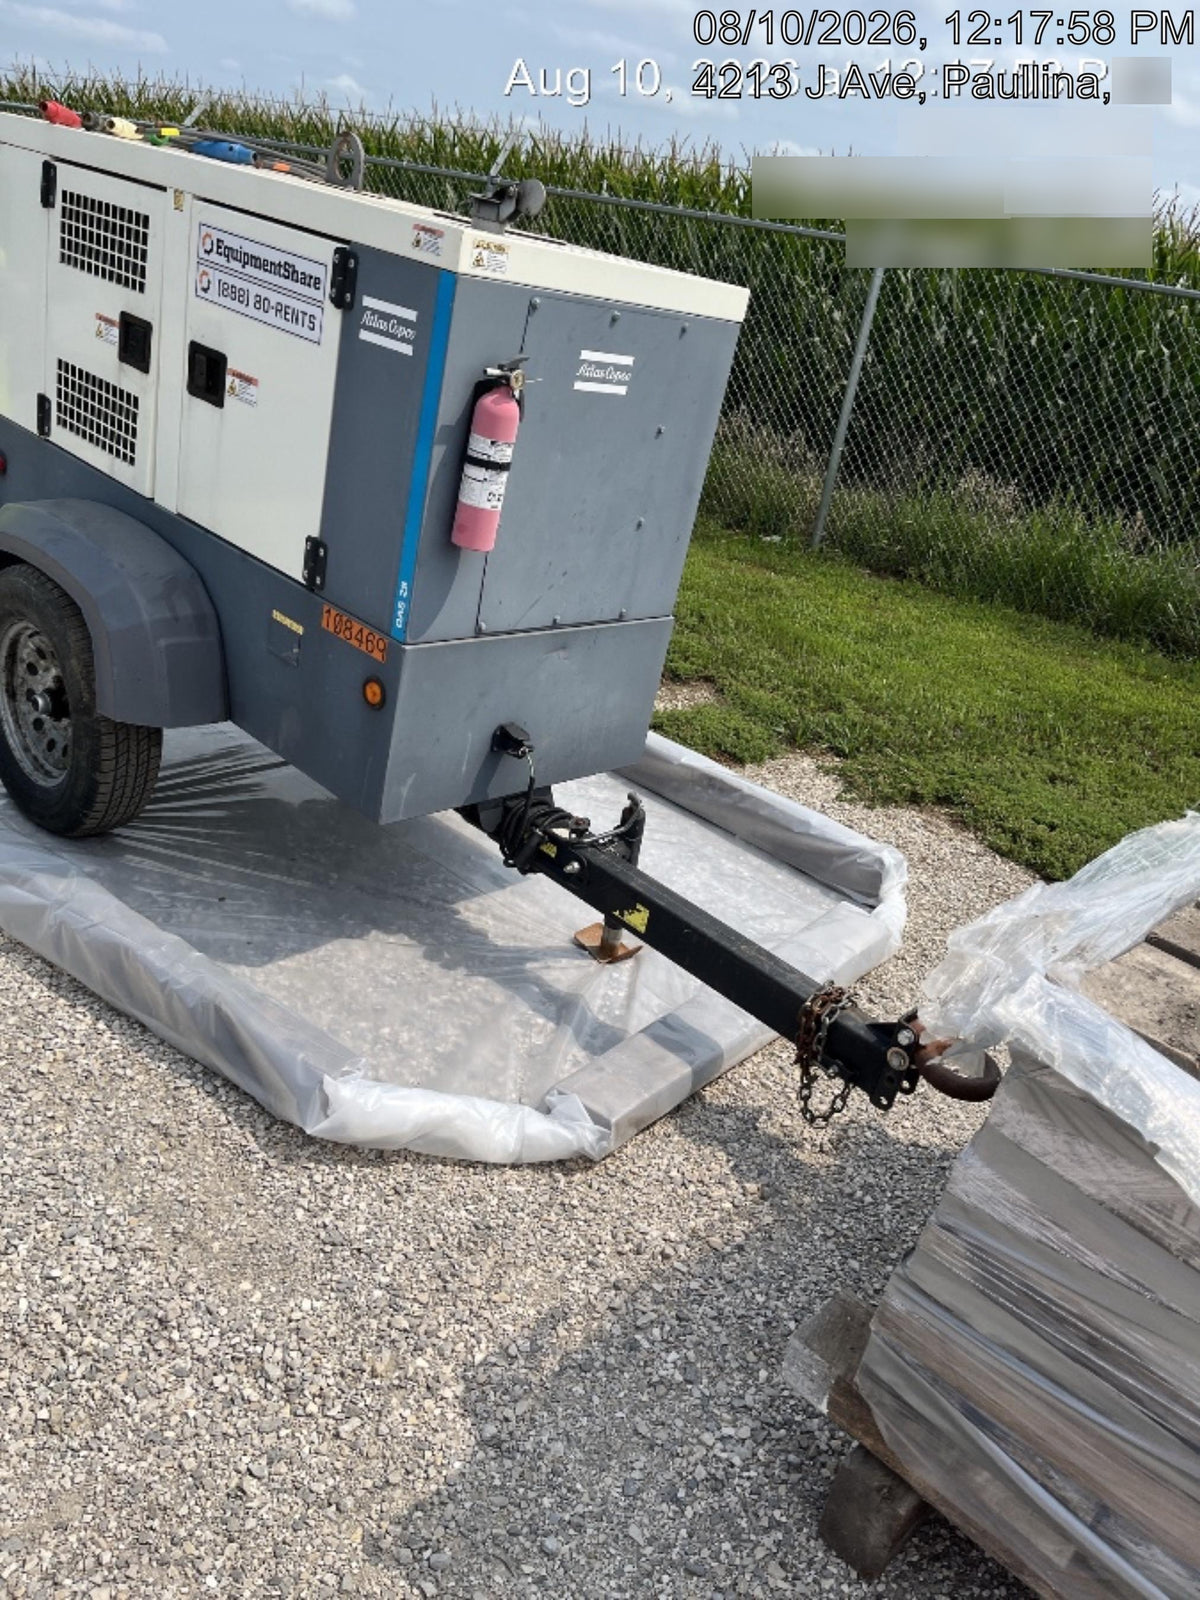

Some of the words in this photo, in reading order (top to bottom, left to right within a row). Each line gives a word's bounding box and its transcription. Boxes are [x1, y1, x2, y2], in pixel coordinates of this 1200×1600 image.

[215, 237, 322, 291] EquipmentShare
[253, 293, 317, 332] 80-RENTS
[324, 607, 387, 662] 108469
